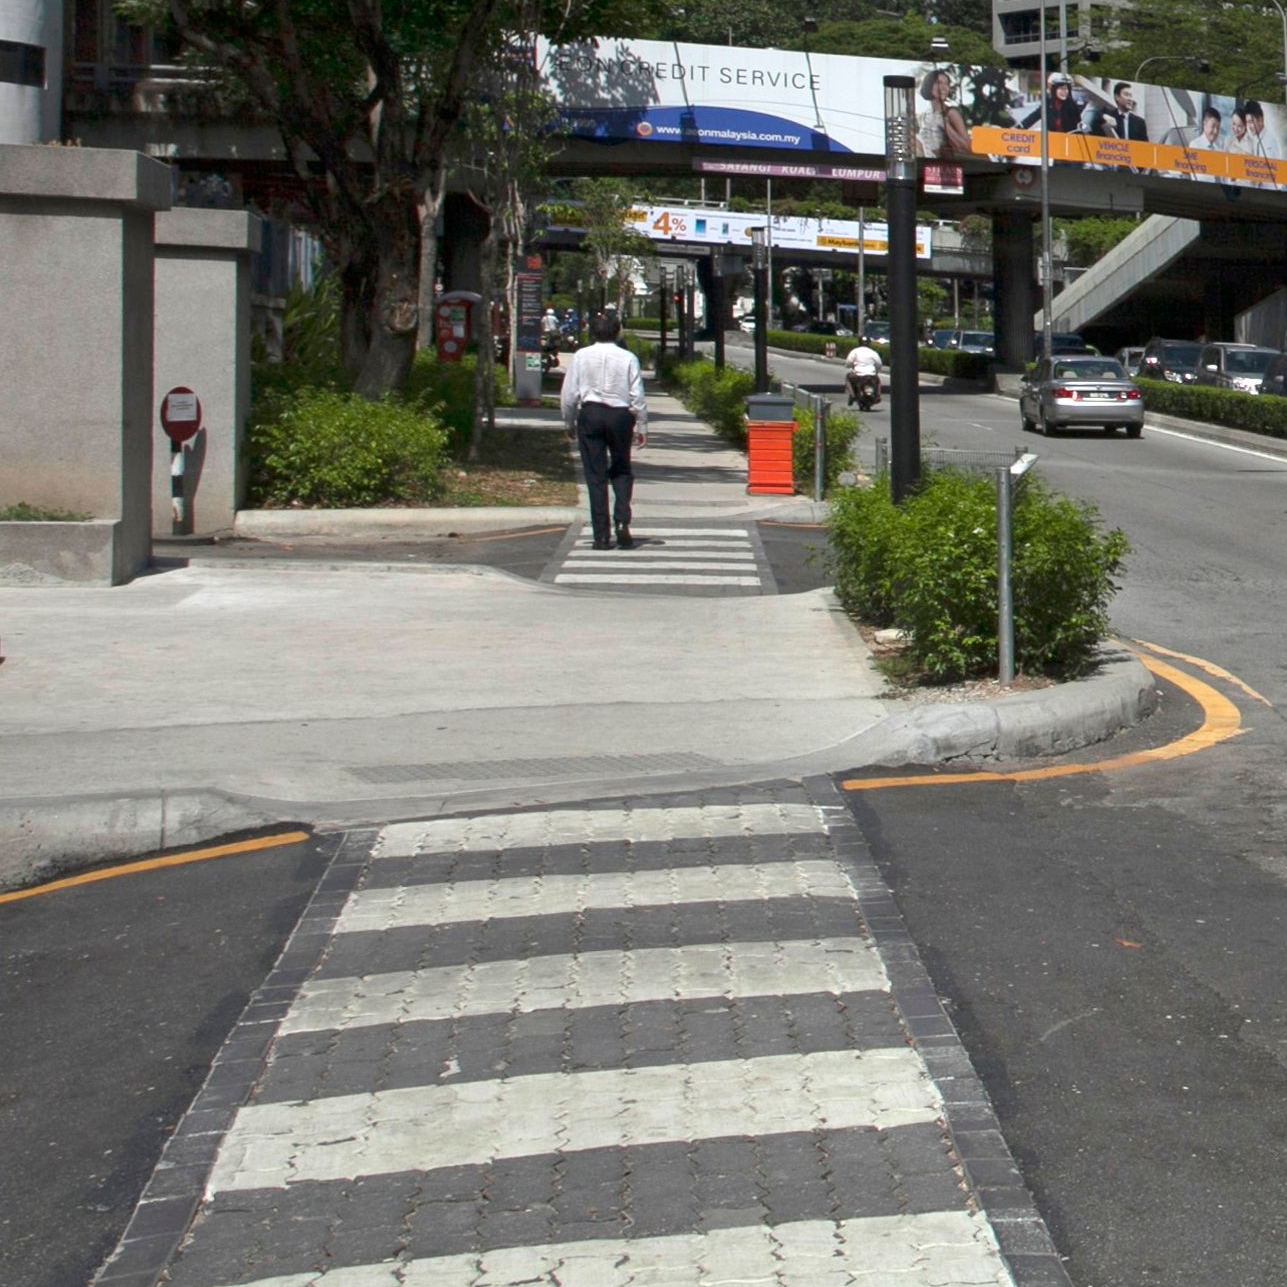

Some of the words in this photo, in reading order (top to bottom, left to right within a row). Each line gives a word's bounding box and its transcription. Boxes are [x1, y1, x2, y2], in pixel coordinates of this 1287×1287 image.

[545, 50, 611, 75] EON
[620, 59, 710, 83] CREDIT
[719, 67, 821, 91] SERVICE
[1001, 132, 1036, 144] CREDIT
[1006, 144, 1031, 154] card
[1095, 150, 1132, 164] financing
[831, 168, 882, 180] LUMPUR
